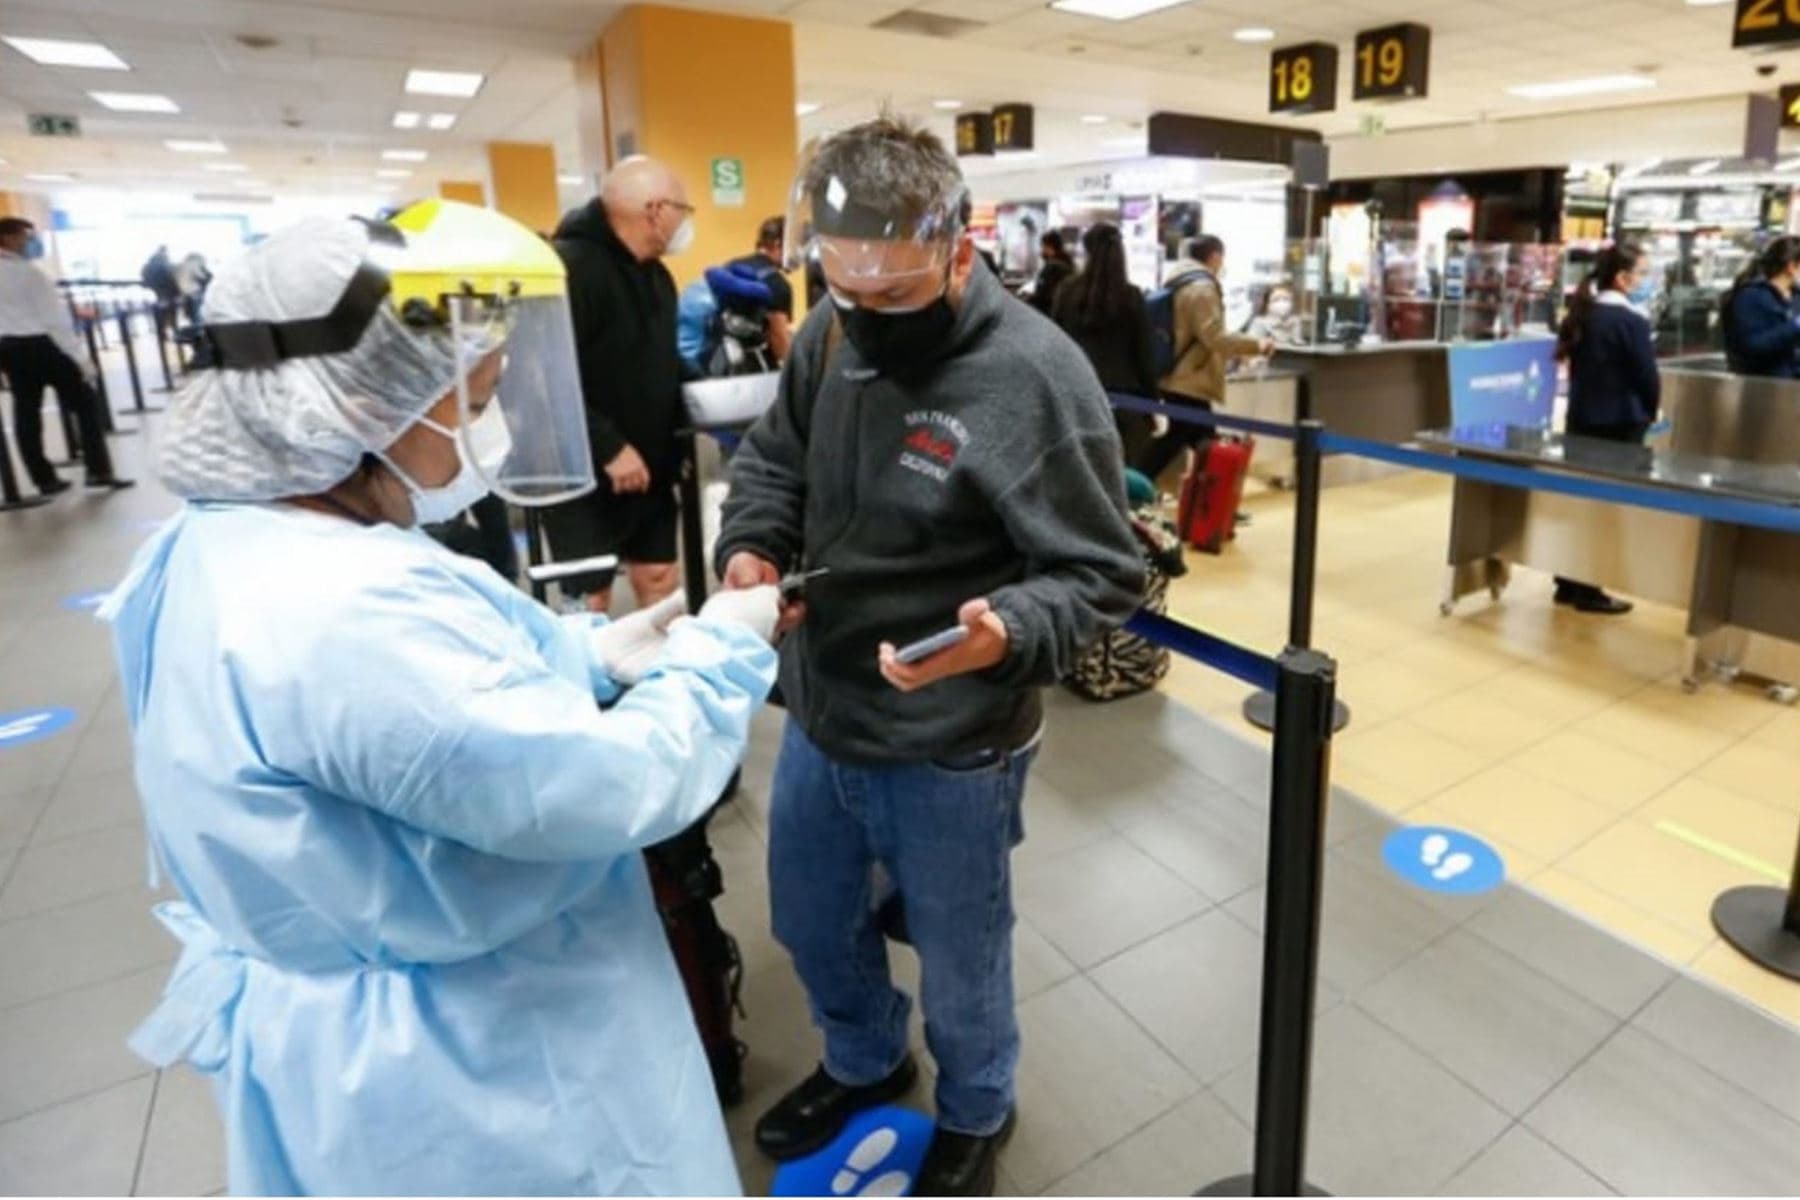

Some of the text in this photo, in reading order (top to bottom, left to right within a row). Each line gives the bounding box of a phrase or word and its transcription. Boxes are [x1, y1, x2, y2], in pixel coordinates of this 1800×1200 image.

[1275, 55, 1312, 102] 18
[1360, 38, 1404, 88] 19
[993, 111, 1014, 146] 17
[717, 160, 738, 187] S
